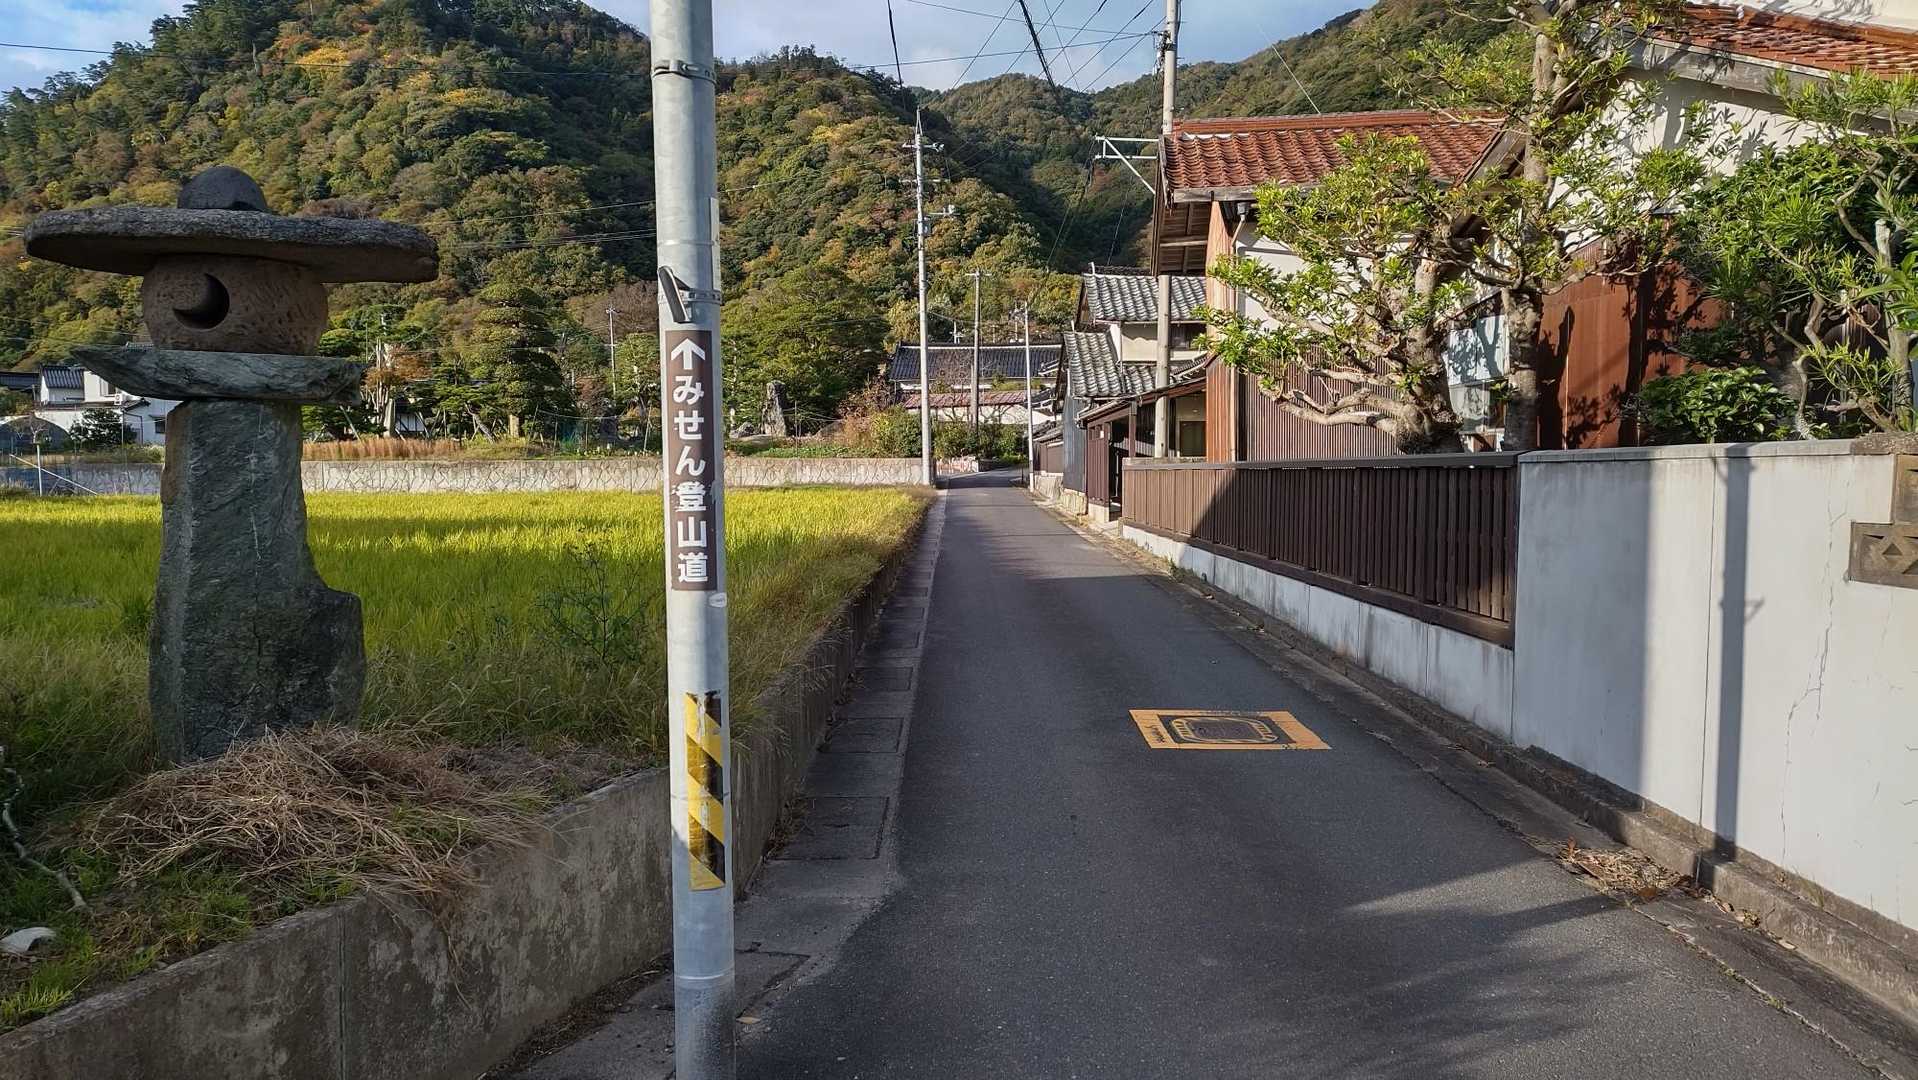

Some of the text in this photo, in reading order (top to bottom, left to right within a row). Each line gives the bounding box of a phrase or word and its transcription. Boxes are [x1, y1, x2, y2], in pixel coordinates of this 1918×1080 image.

[672, 375, 708, 583] みせん登山道
